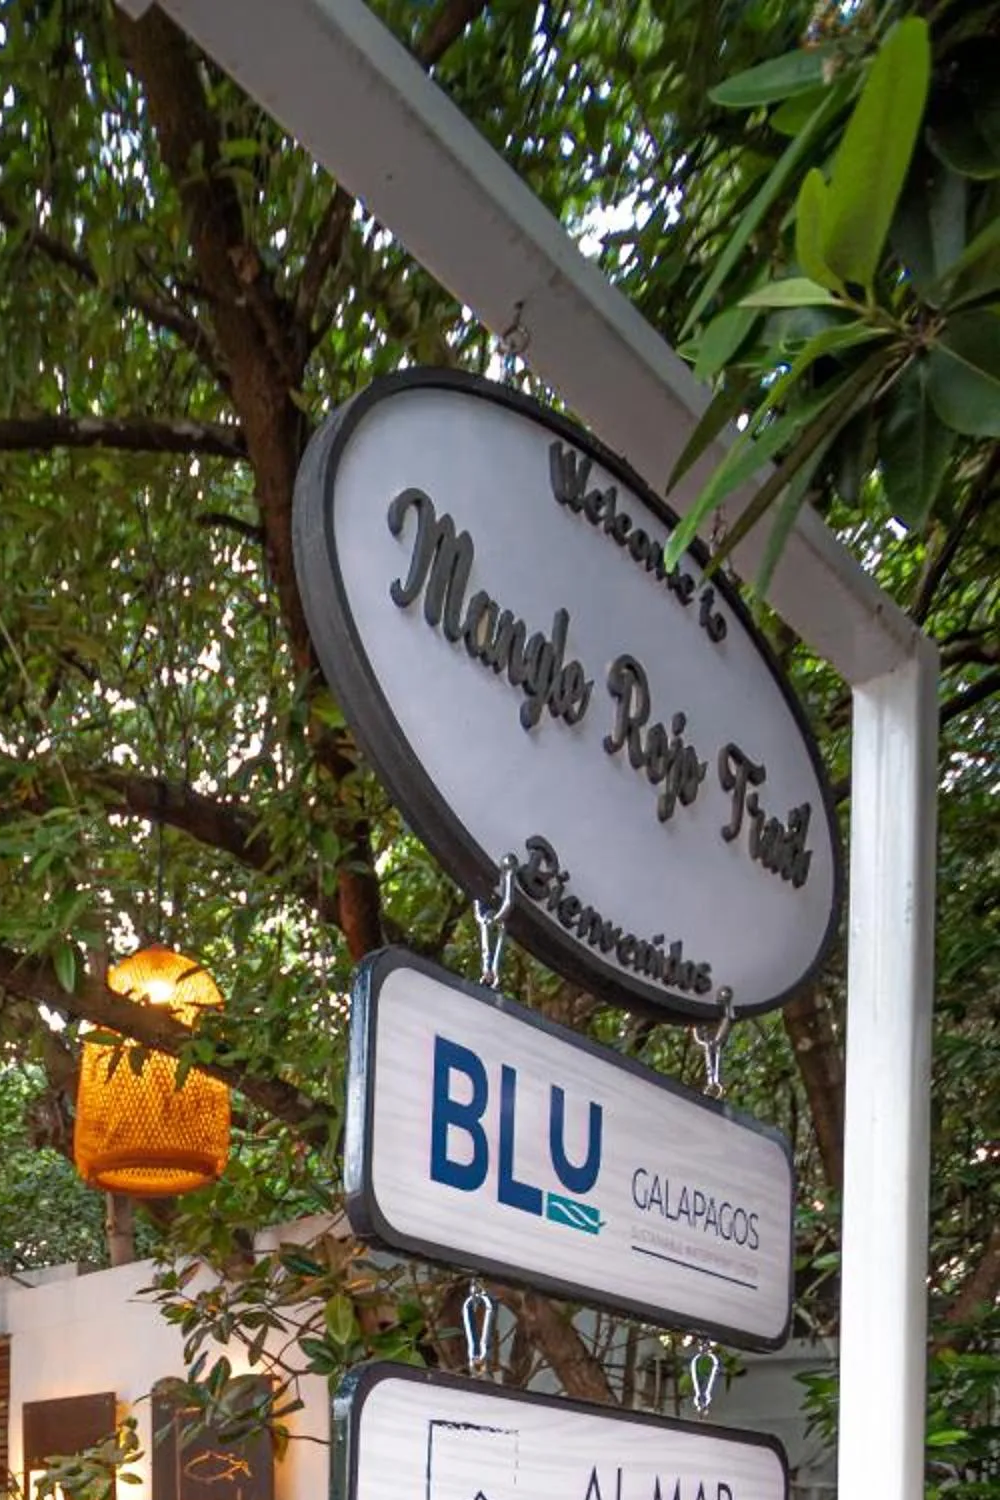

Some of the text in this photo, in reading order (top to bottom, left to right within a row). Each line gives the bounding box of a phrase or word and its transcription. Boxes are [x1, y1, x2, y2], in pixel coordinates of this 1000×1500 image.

[549, 441, 727, 643] Welcome to
[388, 487, 594, 730] Mangle
[603, 654, 708, 824] Rojo
[429, 1034, 603, 1217] BLU
[631, 1167, 760, 1250] GALAPAGOS
